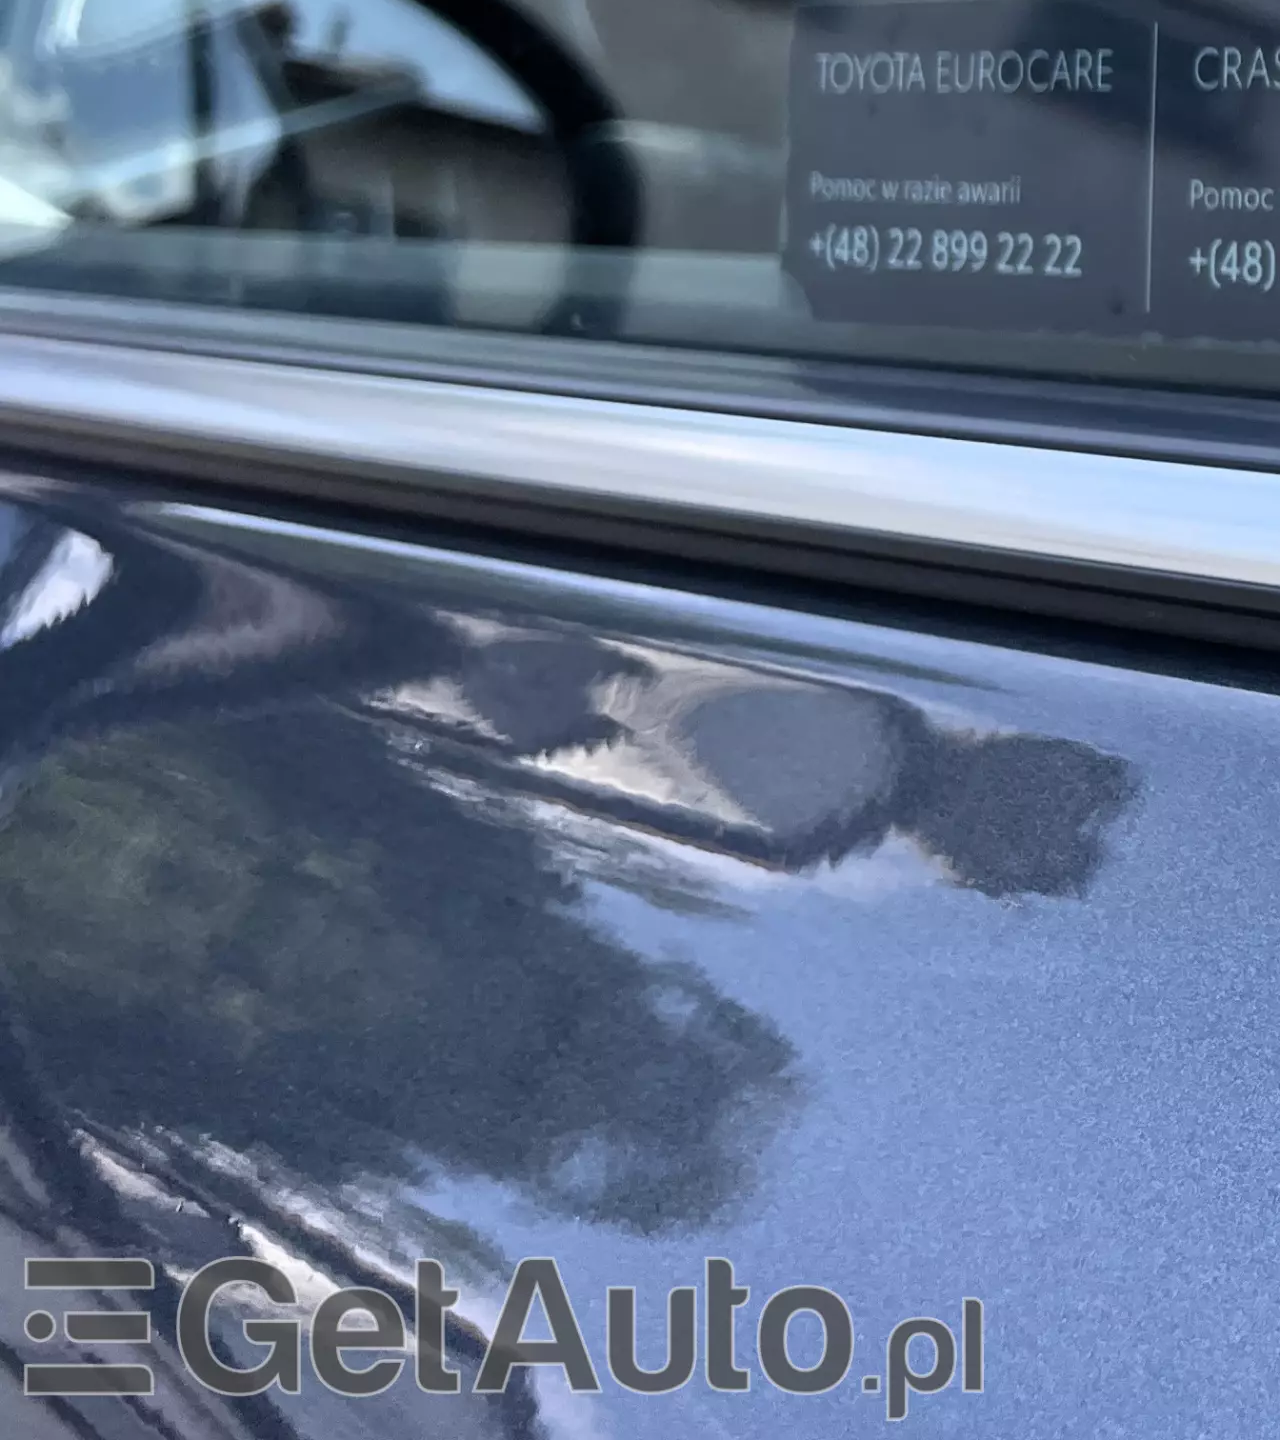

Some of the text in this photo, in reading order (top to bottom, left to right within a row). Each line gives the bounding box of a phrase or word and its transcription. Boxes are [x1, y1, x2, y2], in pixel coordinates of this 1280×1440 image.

[815, 48, 1114, 94] TOYOTA EUROCARE
[809, 170, 875, 201] Pomoc
[881, 179, 899, 201] w
[904, 174, 953, 203] razie
[1189, 178, 1274, 211] Pomoc
[809, 223, 1083, 278] +(48) 22 899 22 22
[1188, 238, 1276, 293] +(48)
